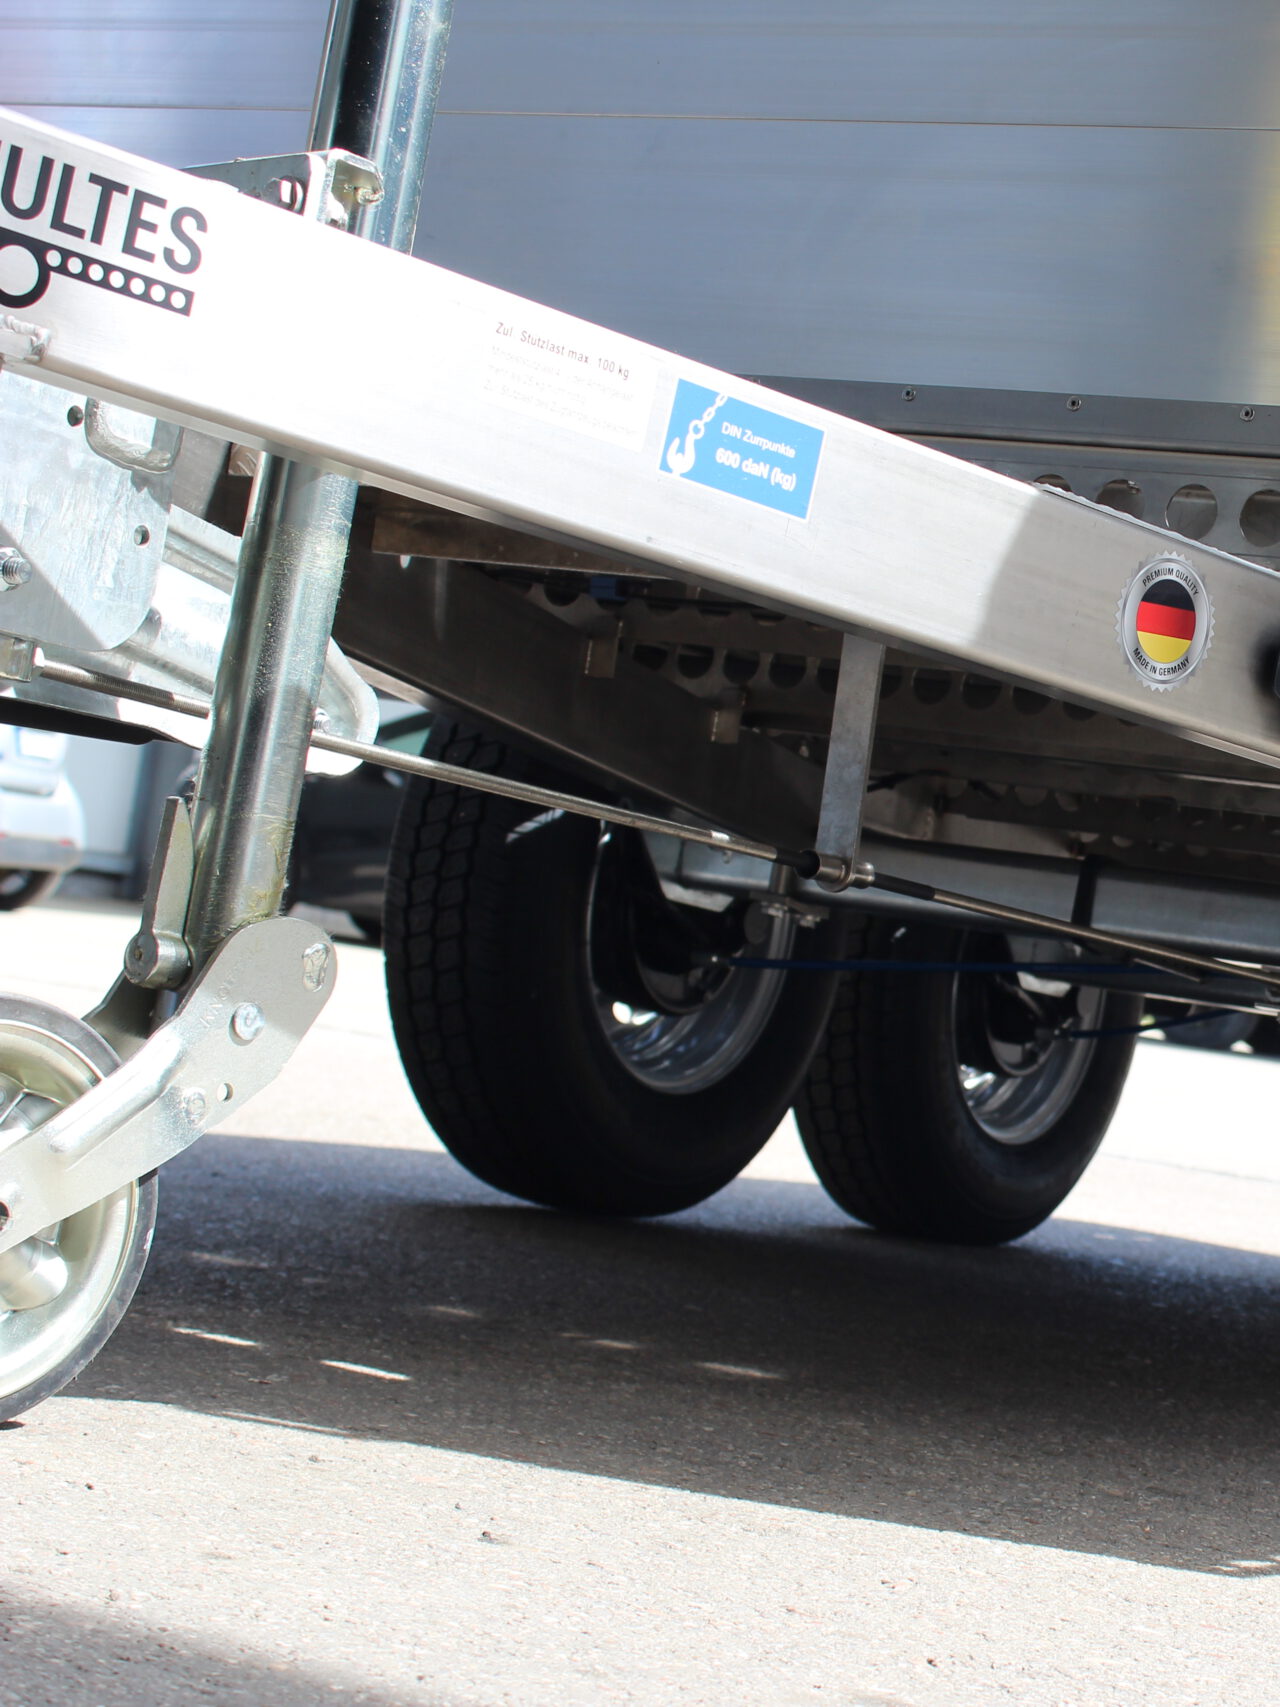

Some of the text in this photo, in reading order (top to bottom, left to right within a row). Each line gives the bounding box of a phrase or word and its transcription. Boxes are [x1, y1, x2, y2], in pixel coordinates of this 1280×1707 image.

[0, 140, 208, 275] ULTES
[598, 357, 616, 373] 100
[617, 365, 630, 381] kg
[721, 421, 796, 459] DIN Zurrpunkte
[715, 447, 797, 492] 600 daN (kg)
[1142, 567, 1199, 597] PREMIUM QUALITY
[1132, 647, 1191, 676] MADE IN GERMANY
